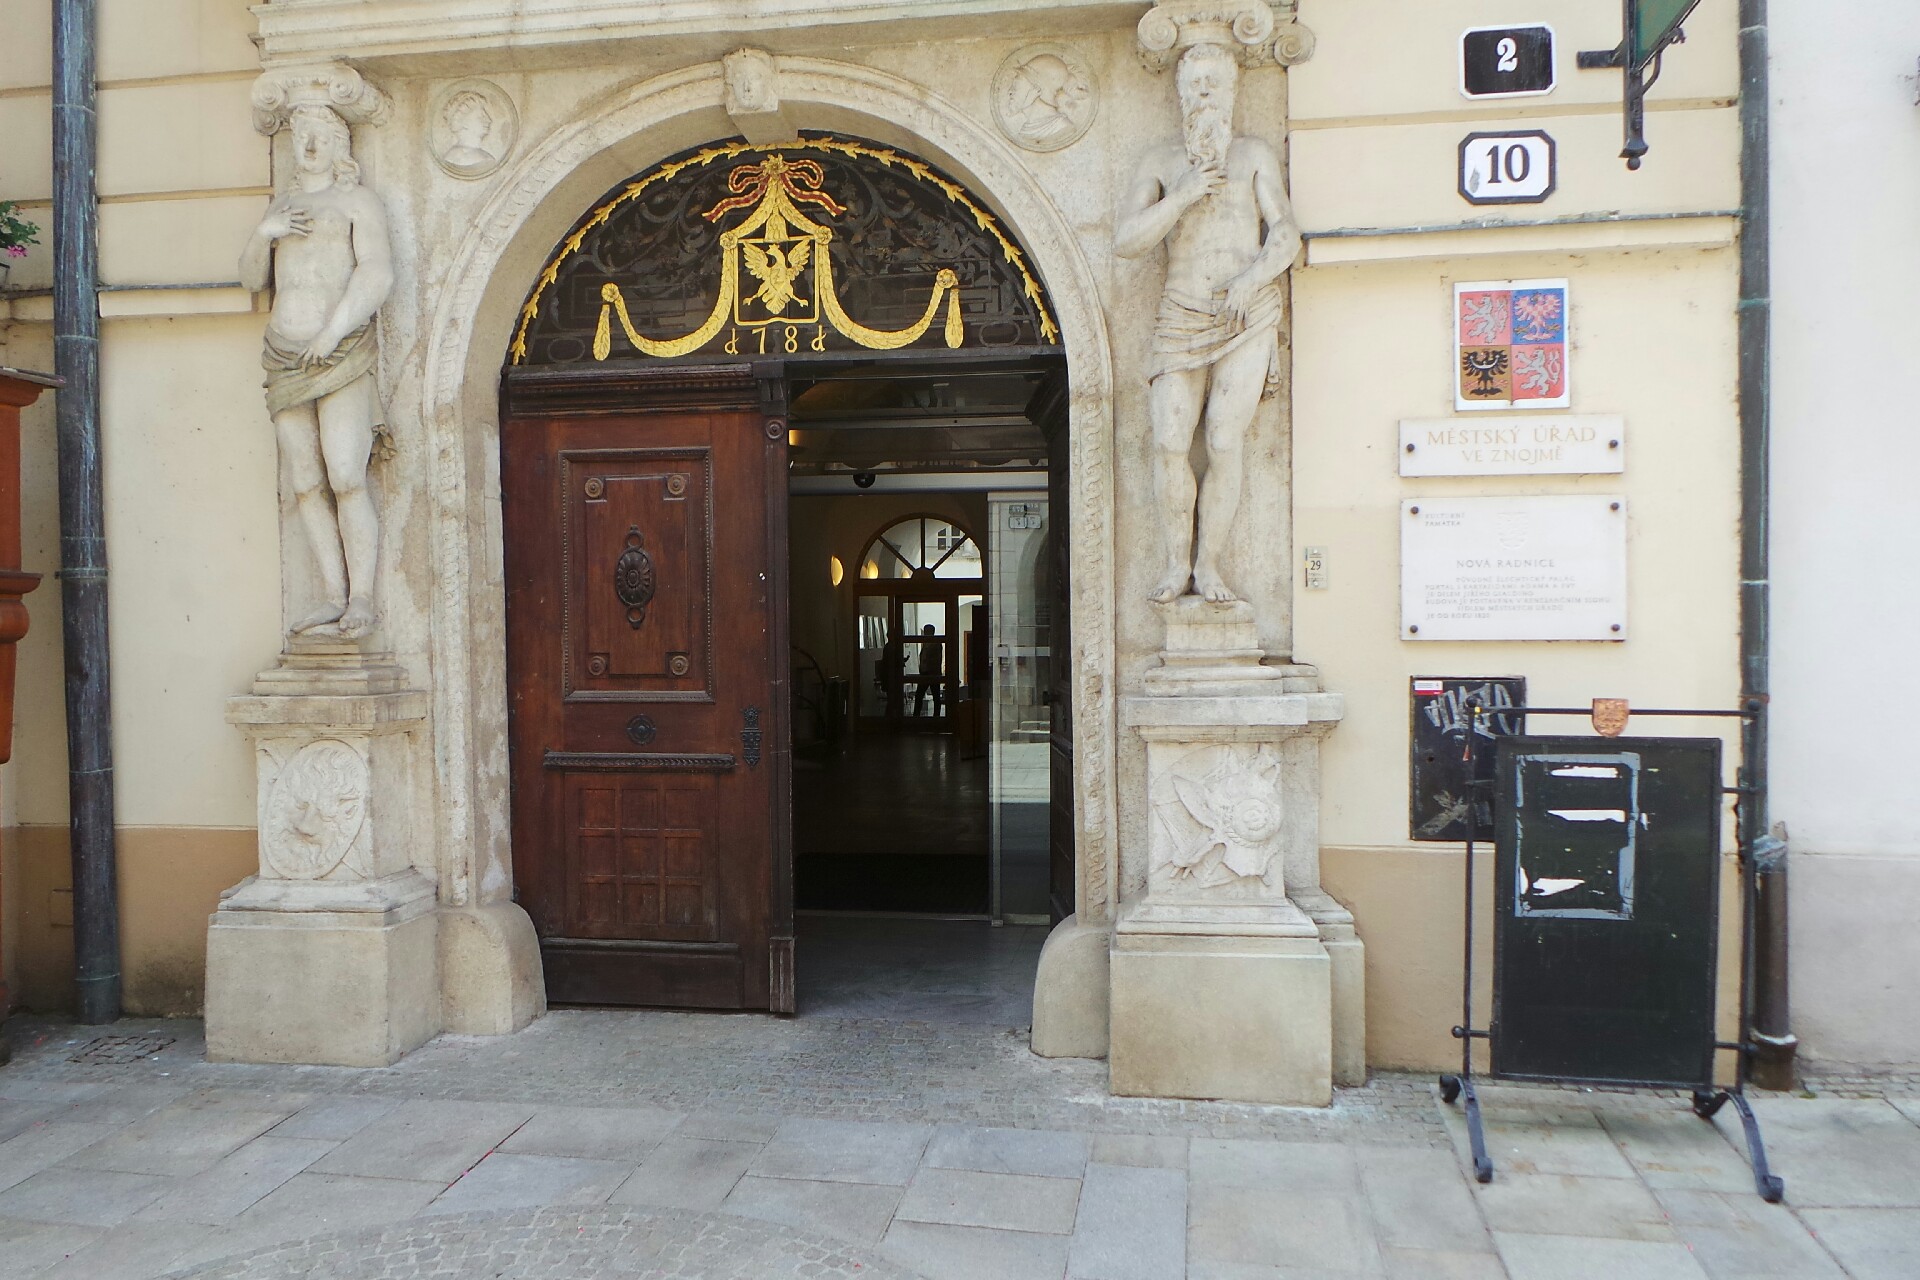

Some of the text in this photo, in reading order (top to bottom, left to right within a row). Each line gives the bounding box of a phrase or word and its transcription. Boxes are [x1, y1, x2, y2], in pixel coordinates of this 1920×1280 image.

[1496, 37, 1519, 73] 2
[1486, 143, 1531, 184] 10
[1461, 449, 1483, 463] VE
[1310, 560, 1322, 571] 29
[1497, 559, 1556, 568] RADNICE
